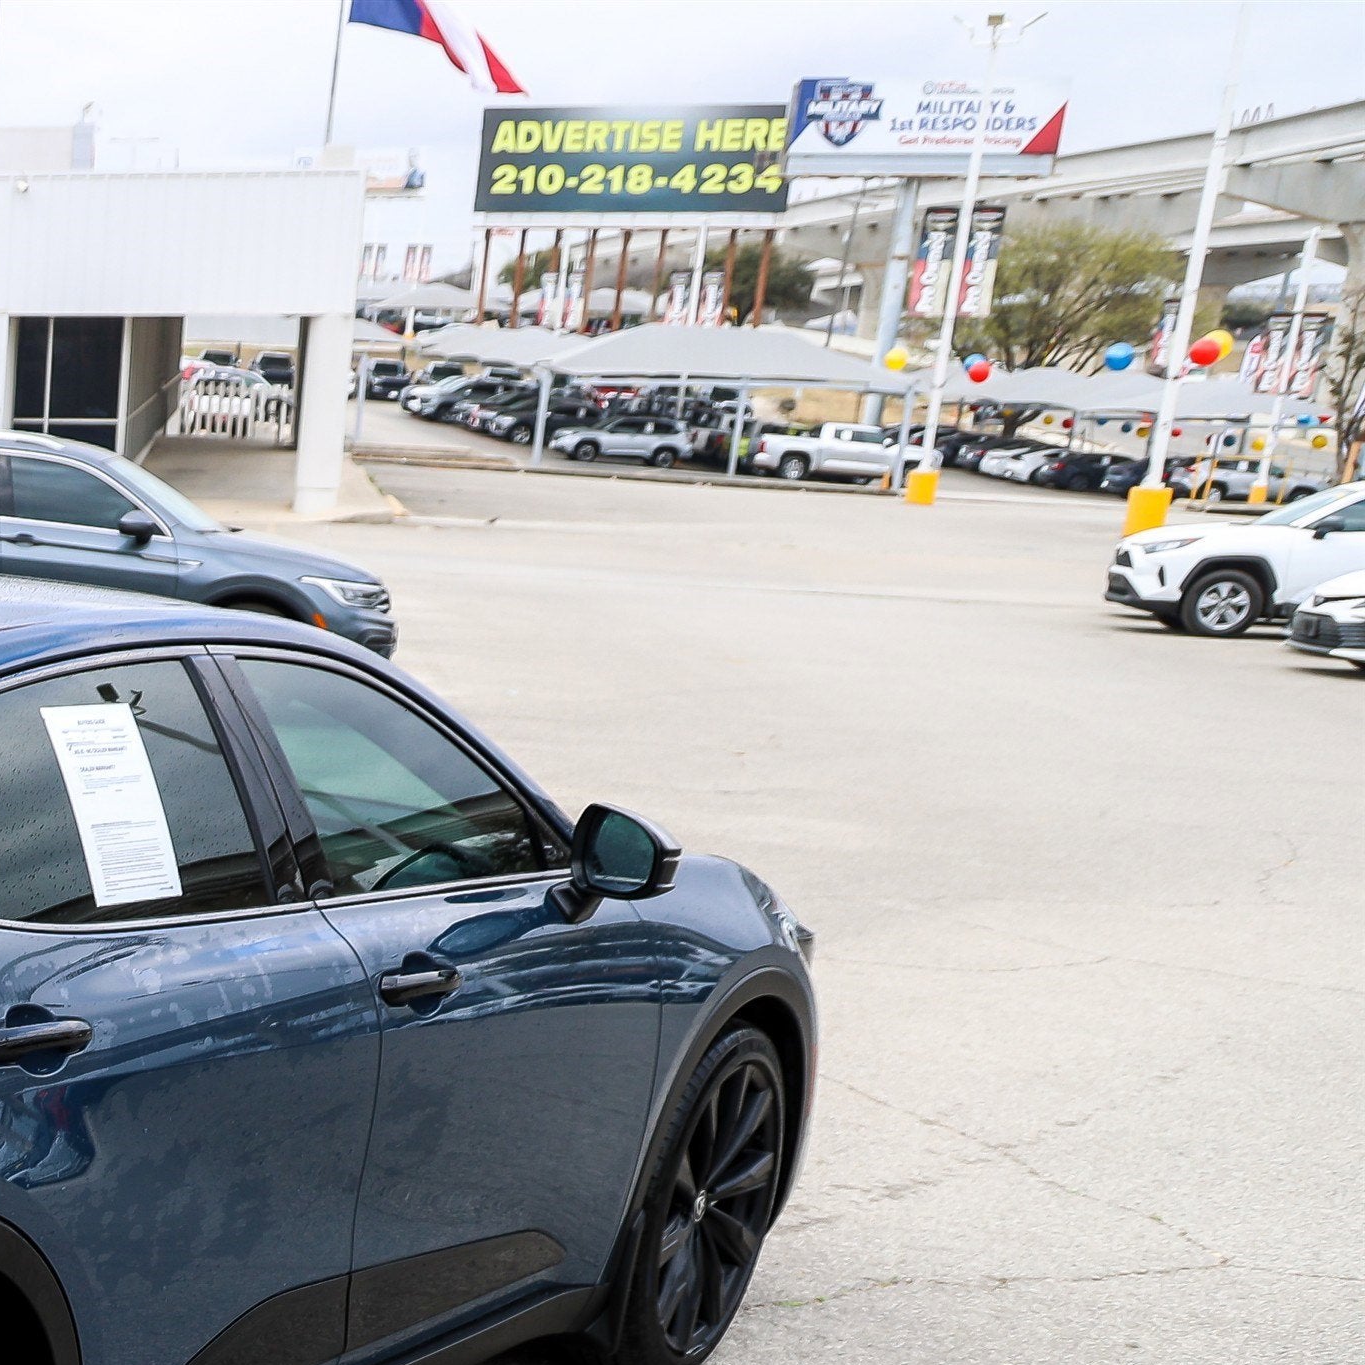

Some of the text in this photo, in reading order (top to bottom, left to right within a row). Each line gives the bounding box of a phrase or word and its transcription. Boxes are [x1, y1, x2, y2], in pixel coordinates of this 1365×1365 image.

[490, 117, 787, 154] ADVERTISE HERE
[889, 117, 914, 132] 1st
[489, 162, 785, 195] 210-218-4234
